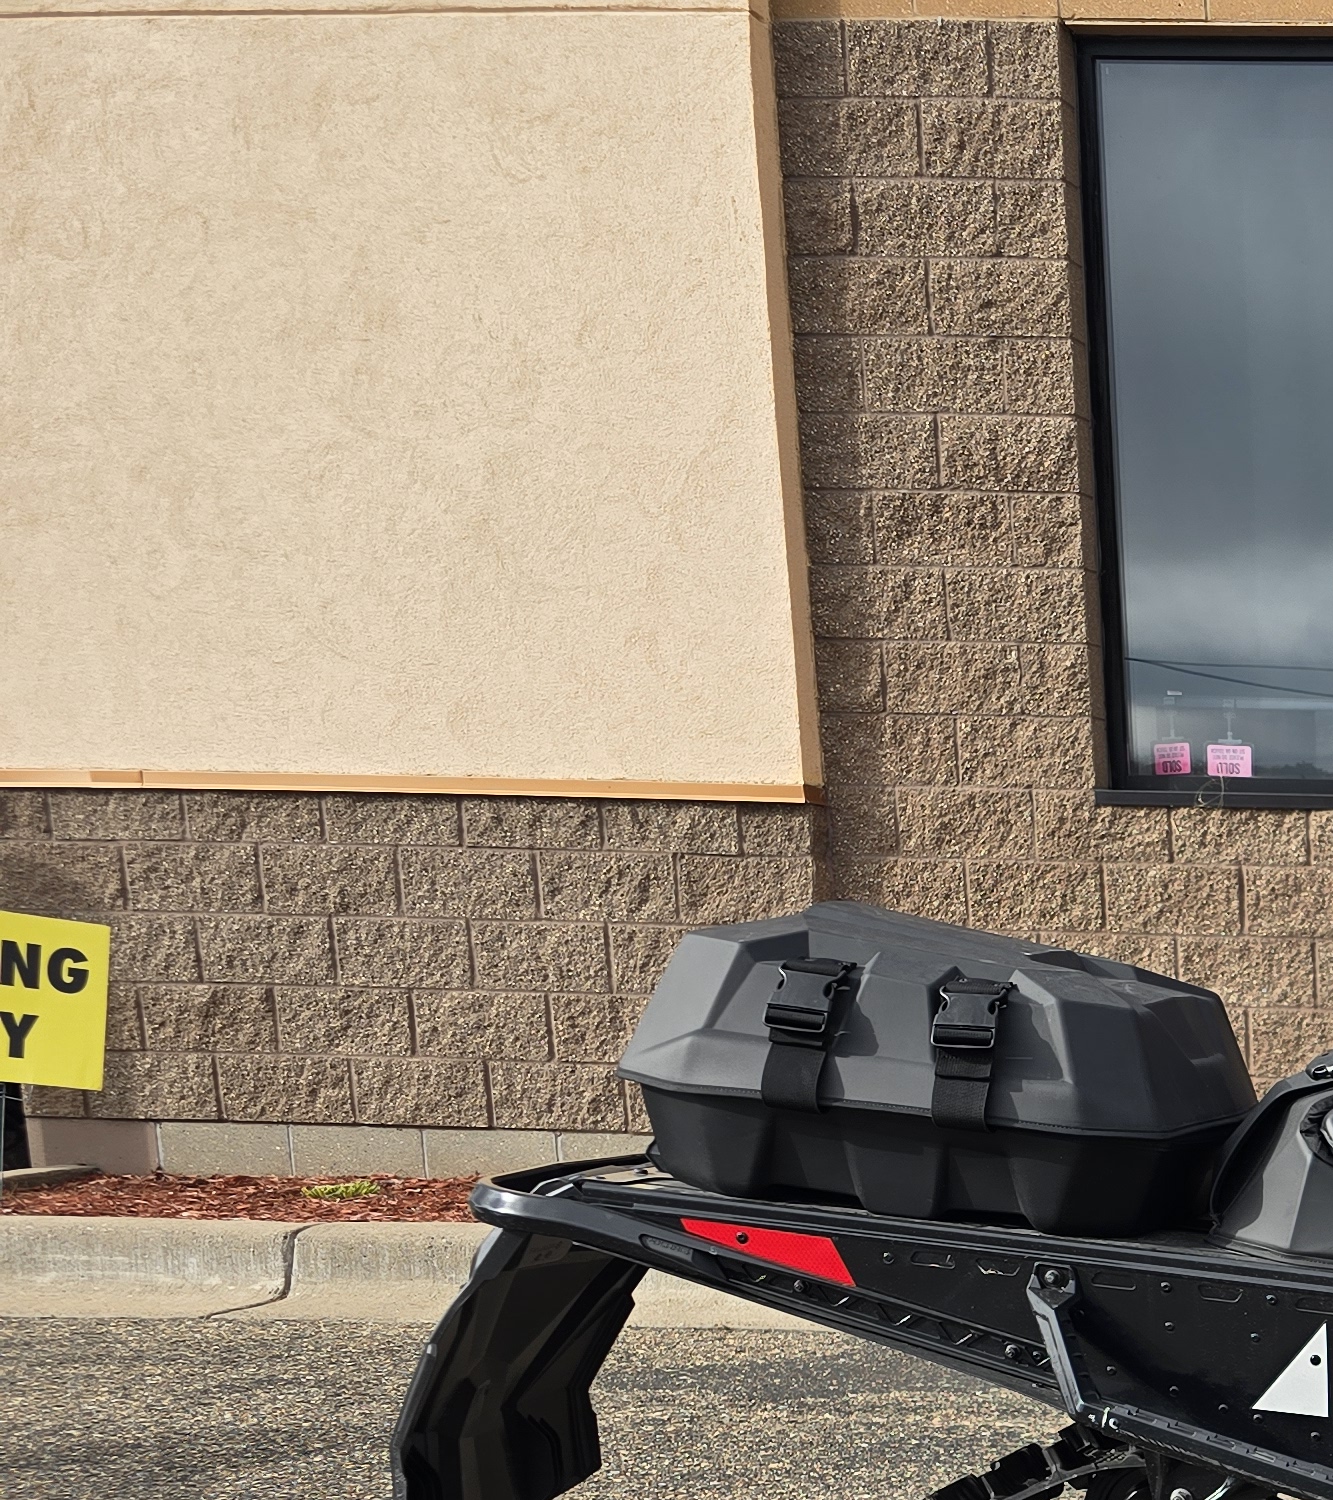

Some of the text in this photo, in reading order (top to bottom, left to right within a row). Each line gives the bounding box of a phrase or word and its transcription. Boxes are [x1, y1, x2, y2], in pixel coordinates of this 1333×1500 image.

[1162, 760, 1182, 773] SOLD
[1, 940, 90, 994] NG
[0, 1011, 39, 1059] Y
